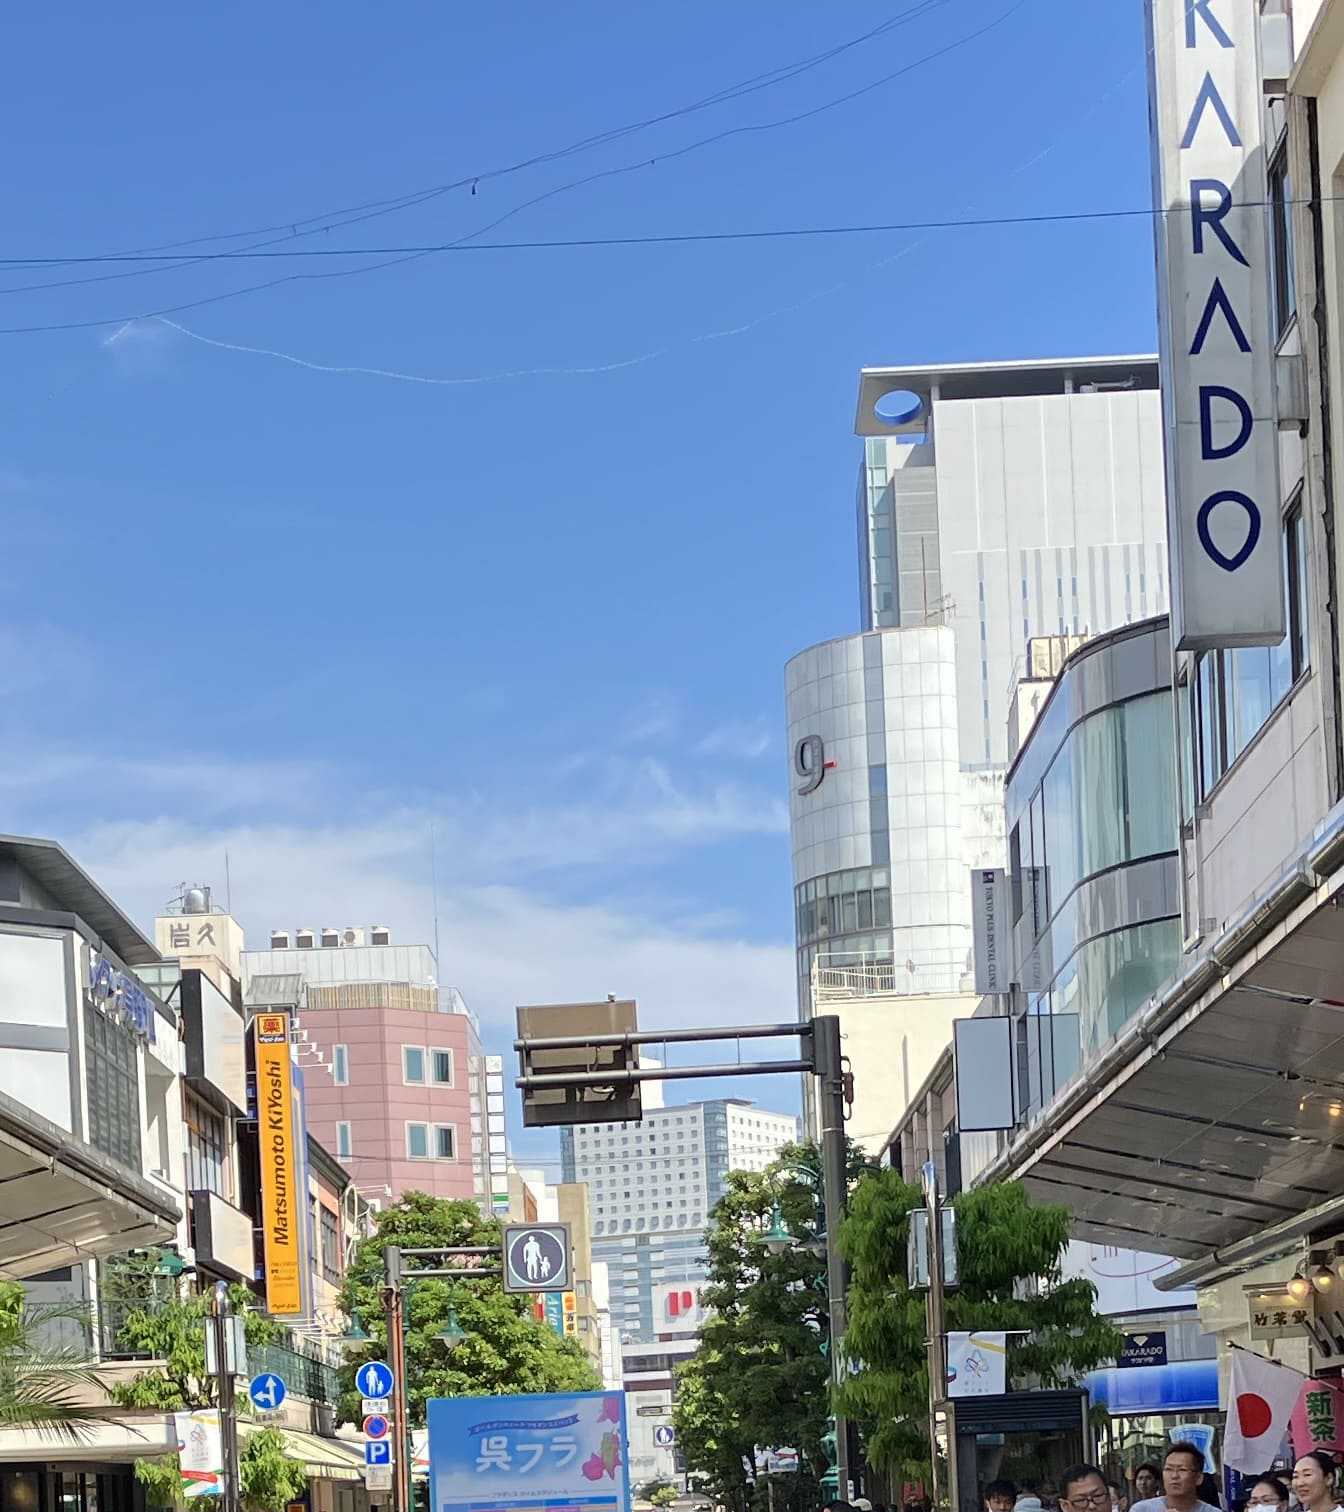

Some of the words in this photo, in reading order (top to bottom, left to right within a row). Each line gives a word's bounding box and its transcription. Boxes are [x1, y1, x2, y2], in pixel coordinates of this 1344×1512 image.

[265, 1060, 284, 1131] KiYoshi
[271, 1135, 289, 1246] Matsumoto
[1305, 1390, 1337, 1443] 新茶
[369, 1442, 386, 1463] P
[475, 1435, 578, 1473] 呉フラ
